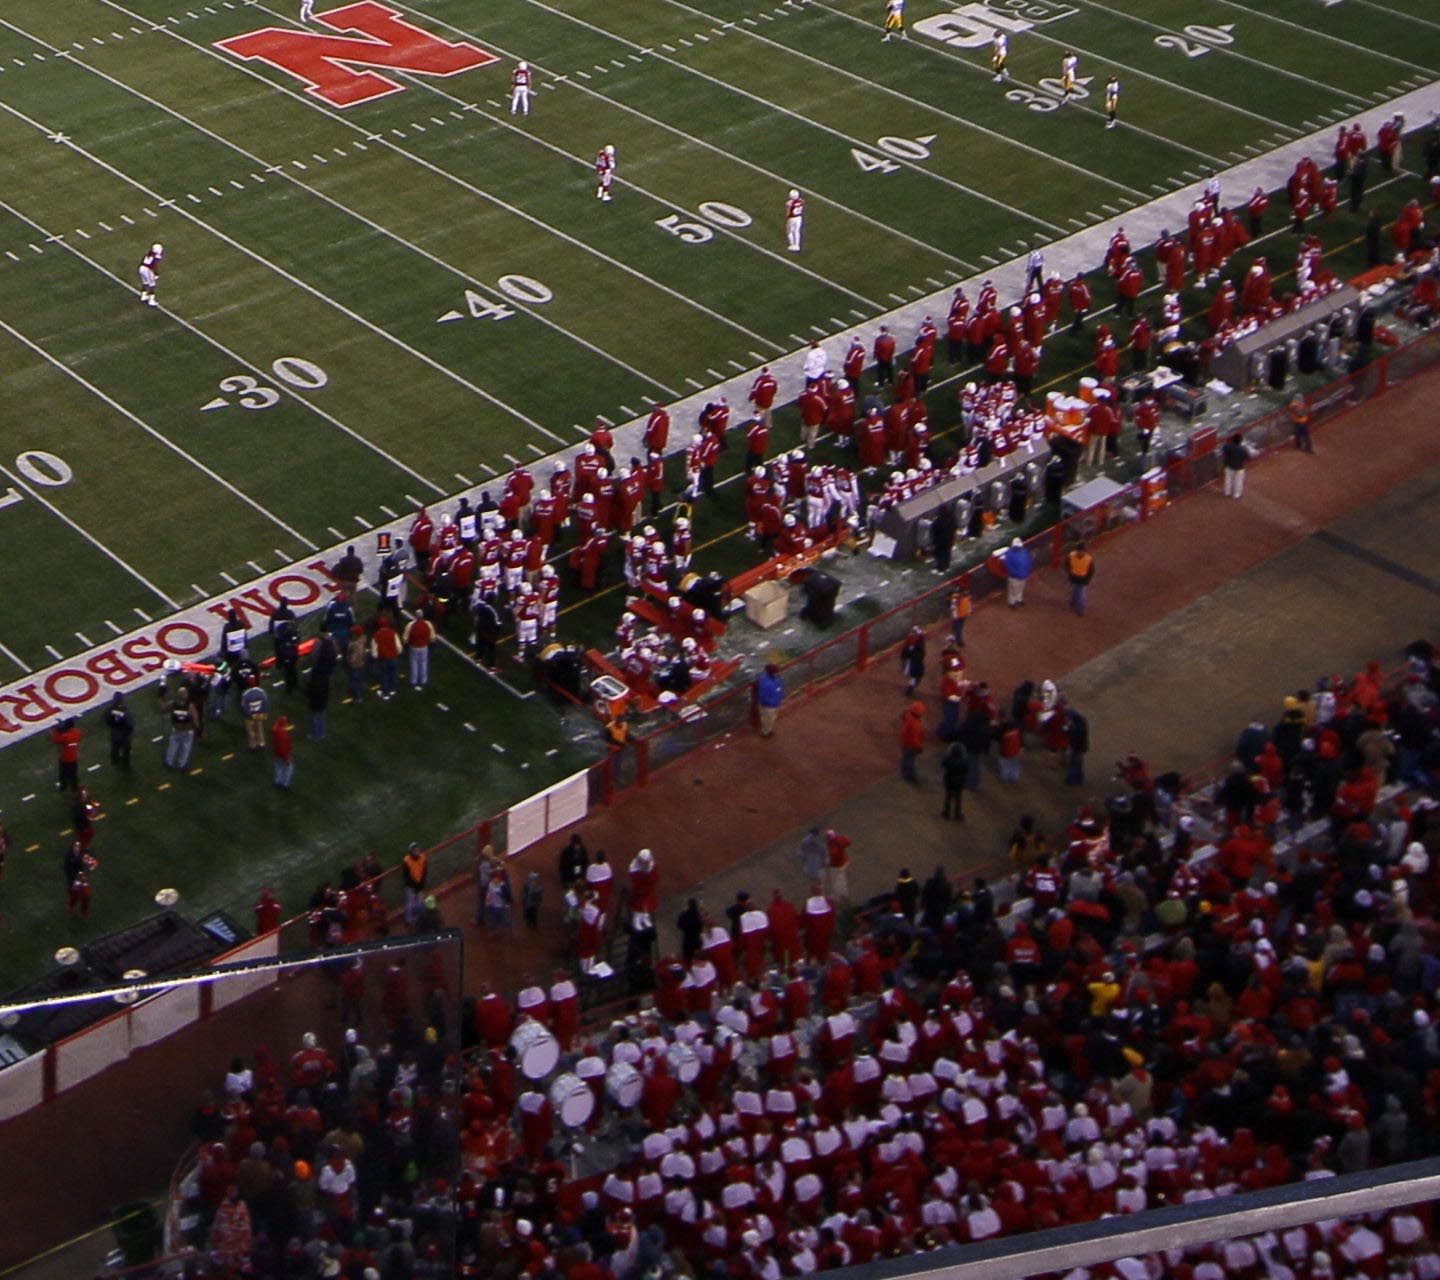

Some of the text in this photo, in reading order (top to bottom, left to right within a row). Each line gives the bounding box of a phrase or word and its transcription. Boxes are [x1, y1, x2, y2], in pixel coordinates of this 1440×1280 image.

[1153, 23, 1234, 58] 20
[849, 135, 930, 177] 40
[654, 200, 755, 244] 50
[465, 273, 554, 323] 40
[218, 355, 329, 411] 30
[206, 559, 344, 631] TOM
